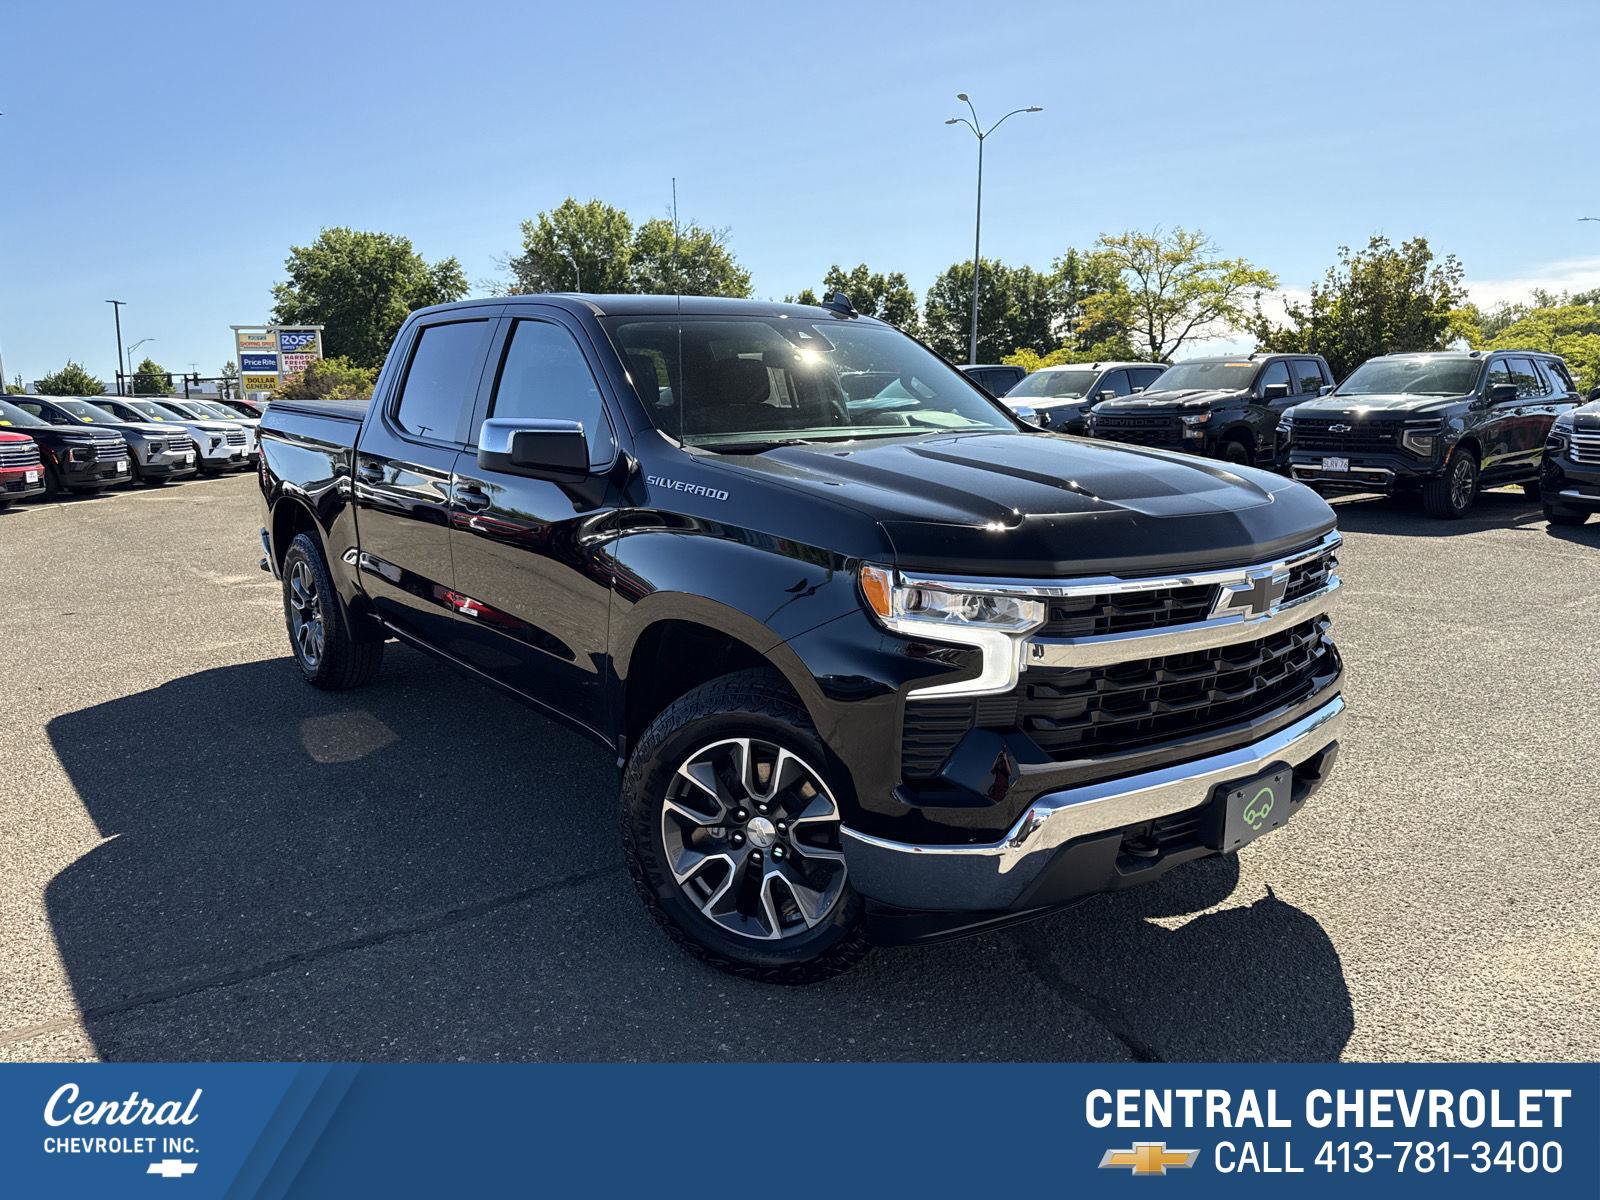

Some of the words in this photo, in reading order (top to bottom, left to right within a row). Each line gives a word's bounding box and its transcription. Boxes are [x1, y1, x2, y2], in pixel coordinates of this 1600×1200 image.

[281, 335, 315, 344] ROSS
[243, 358, 262, 366] Price
[646, 475, 729, 501] SILVERADO
